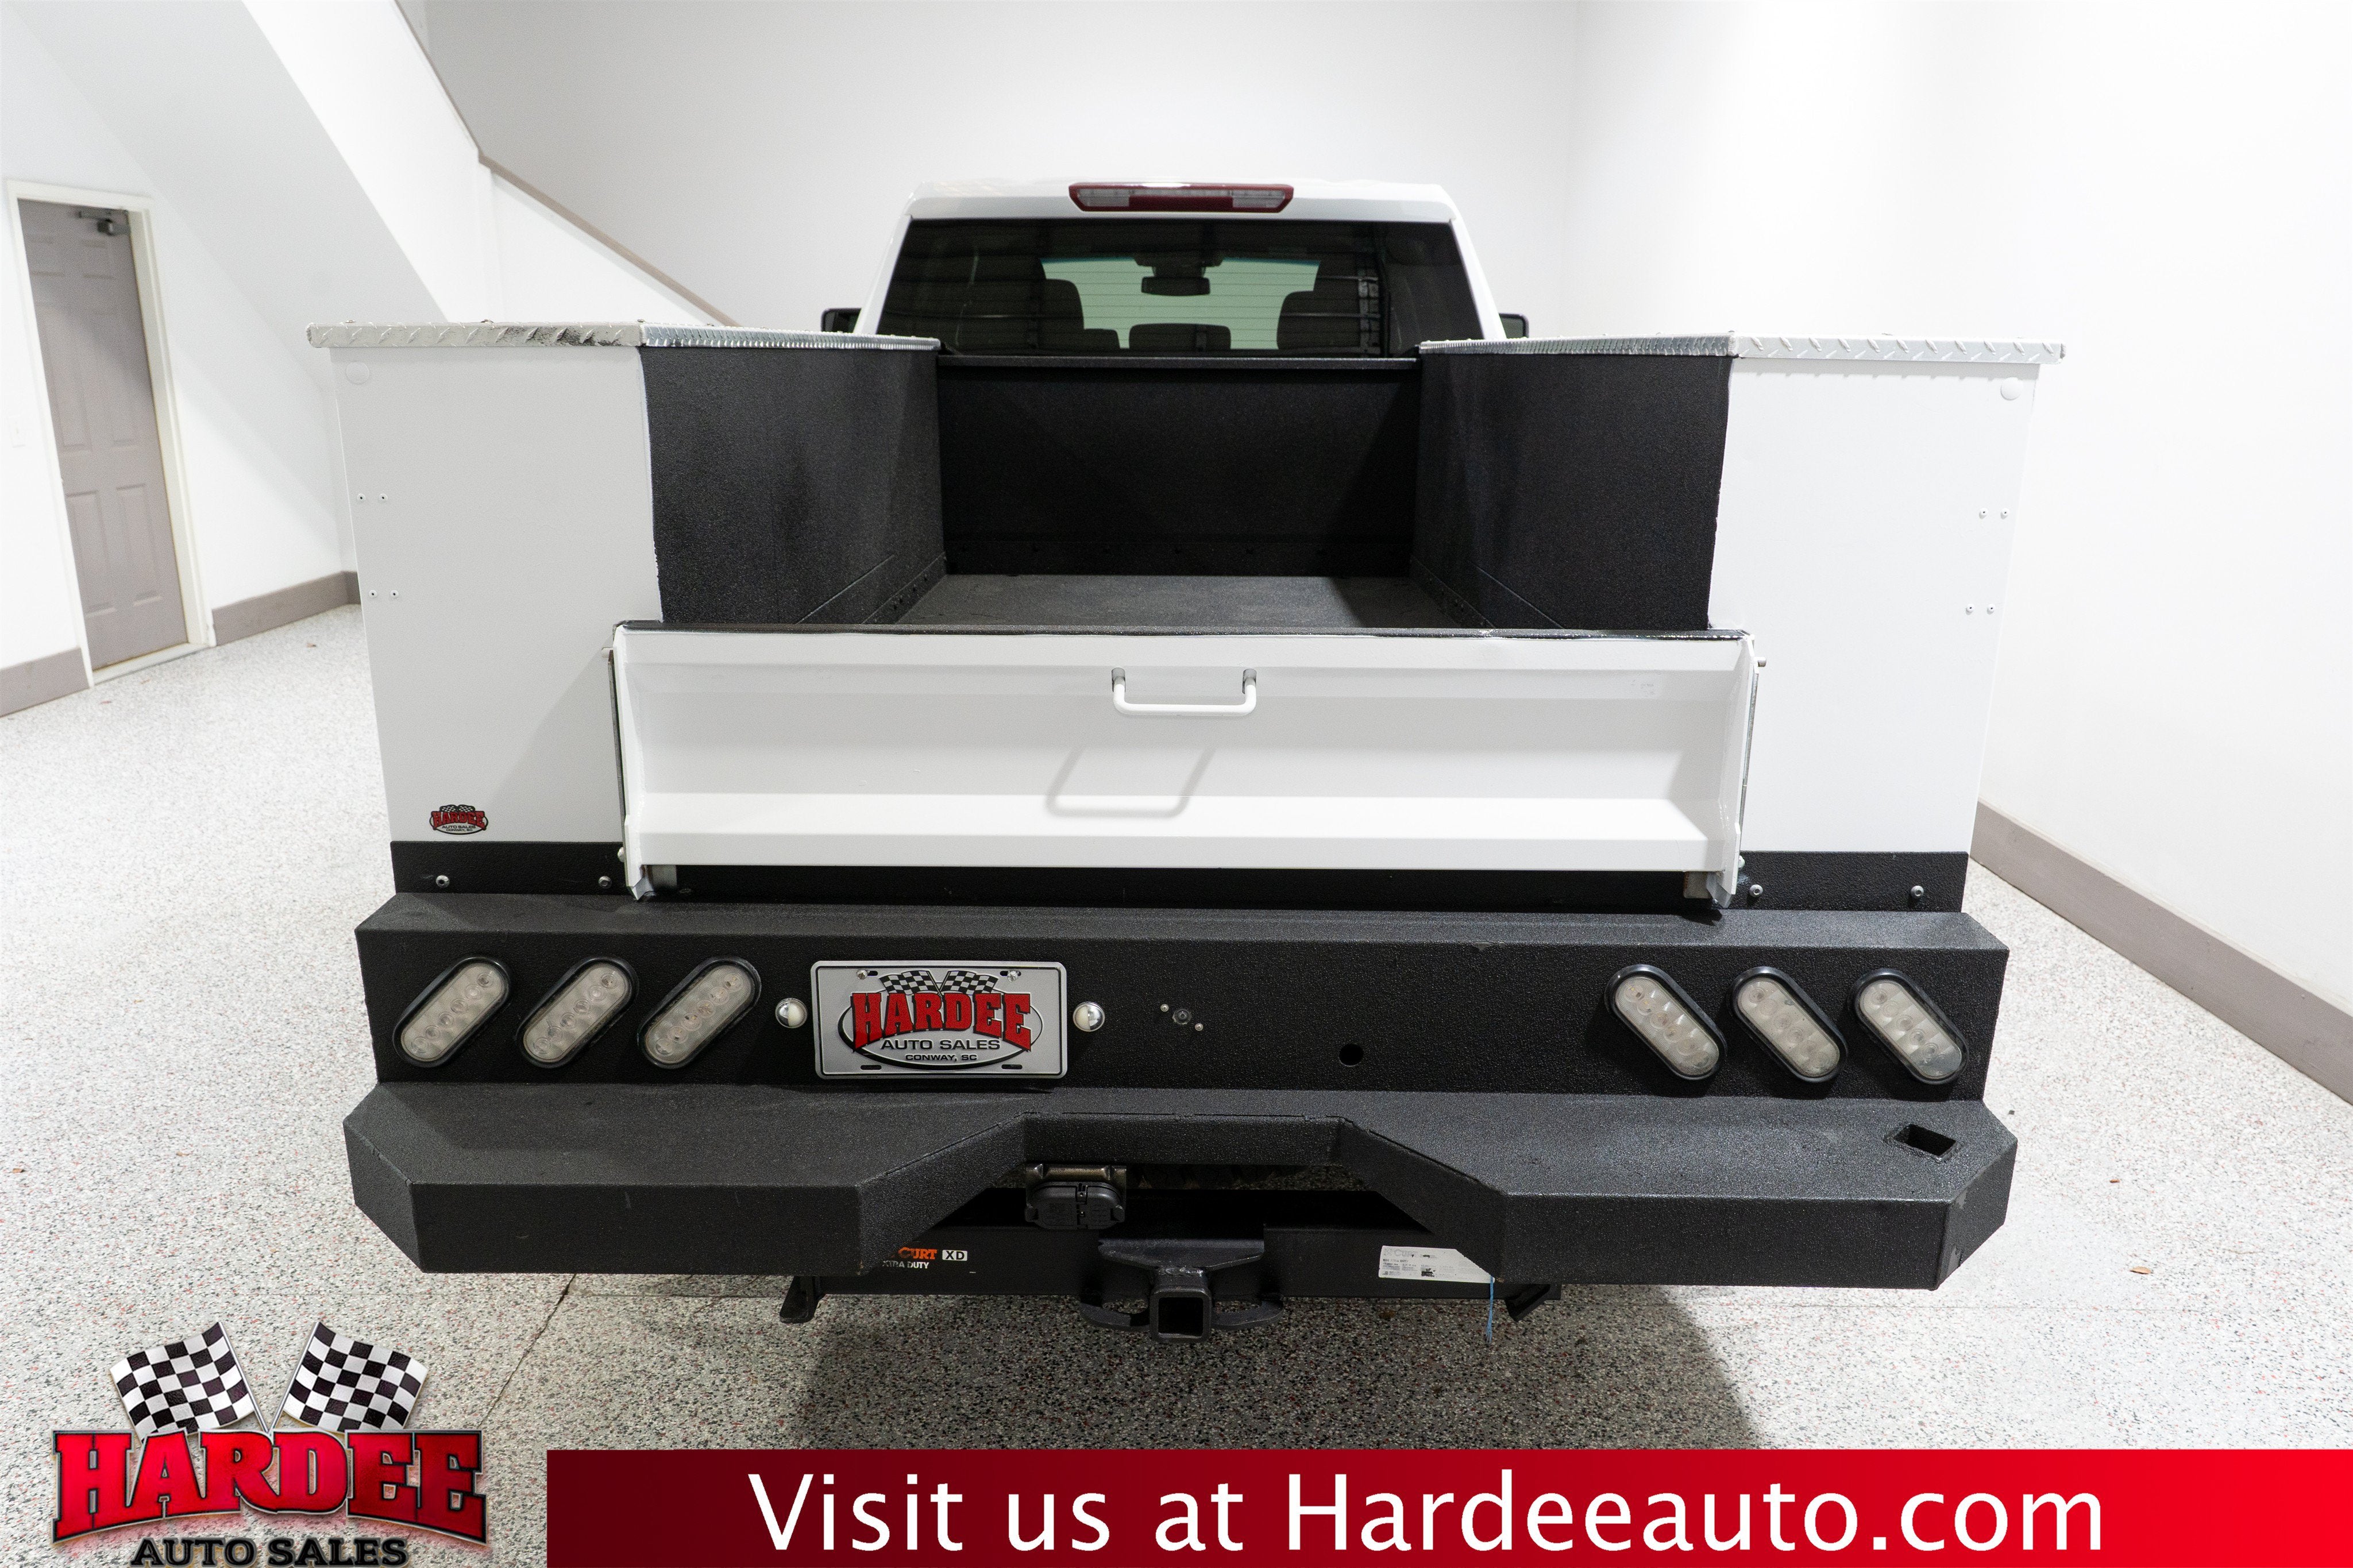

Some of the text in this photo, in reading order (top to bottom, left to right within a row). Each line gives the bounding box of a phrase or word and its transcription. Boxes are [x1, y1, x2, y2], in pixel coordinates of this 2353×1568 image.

[431, 811, 486, 829] HARDEE
[850, 992, 1032, 1052] HARDEE
[881, 1040, 1001, 1050] AUTO SALES
[905, 1054, 957, 1062] CONWAY,
[898, 1247, 966, 1260] CURT XD
